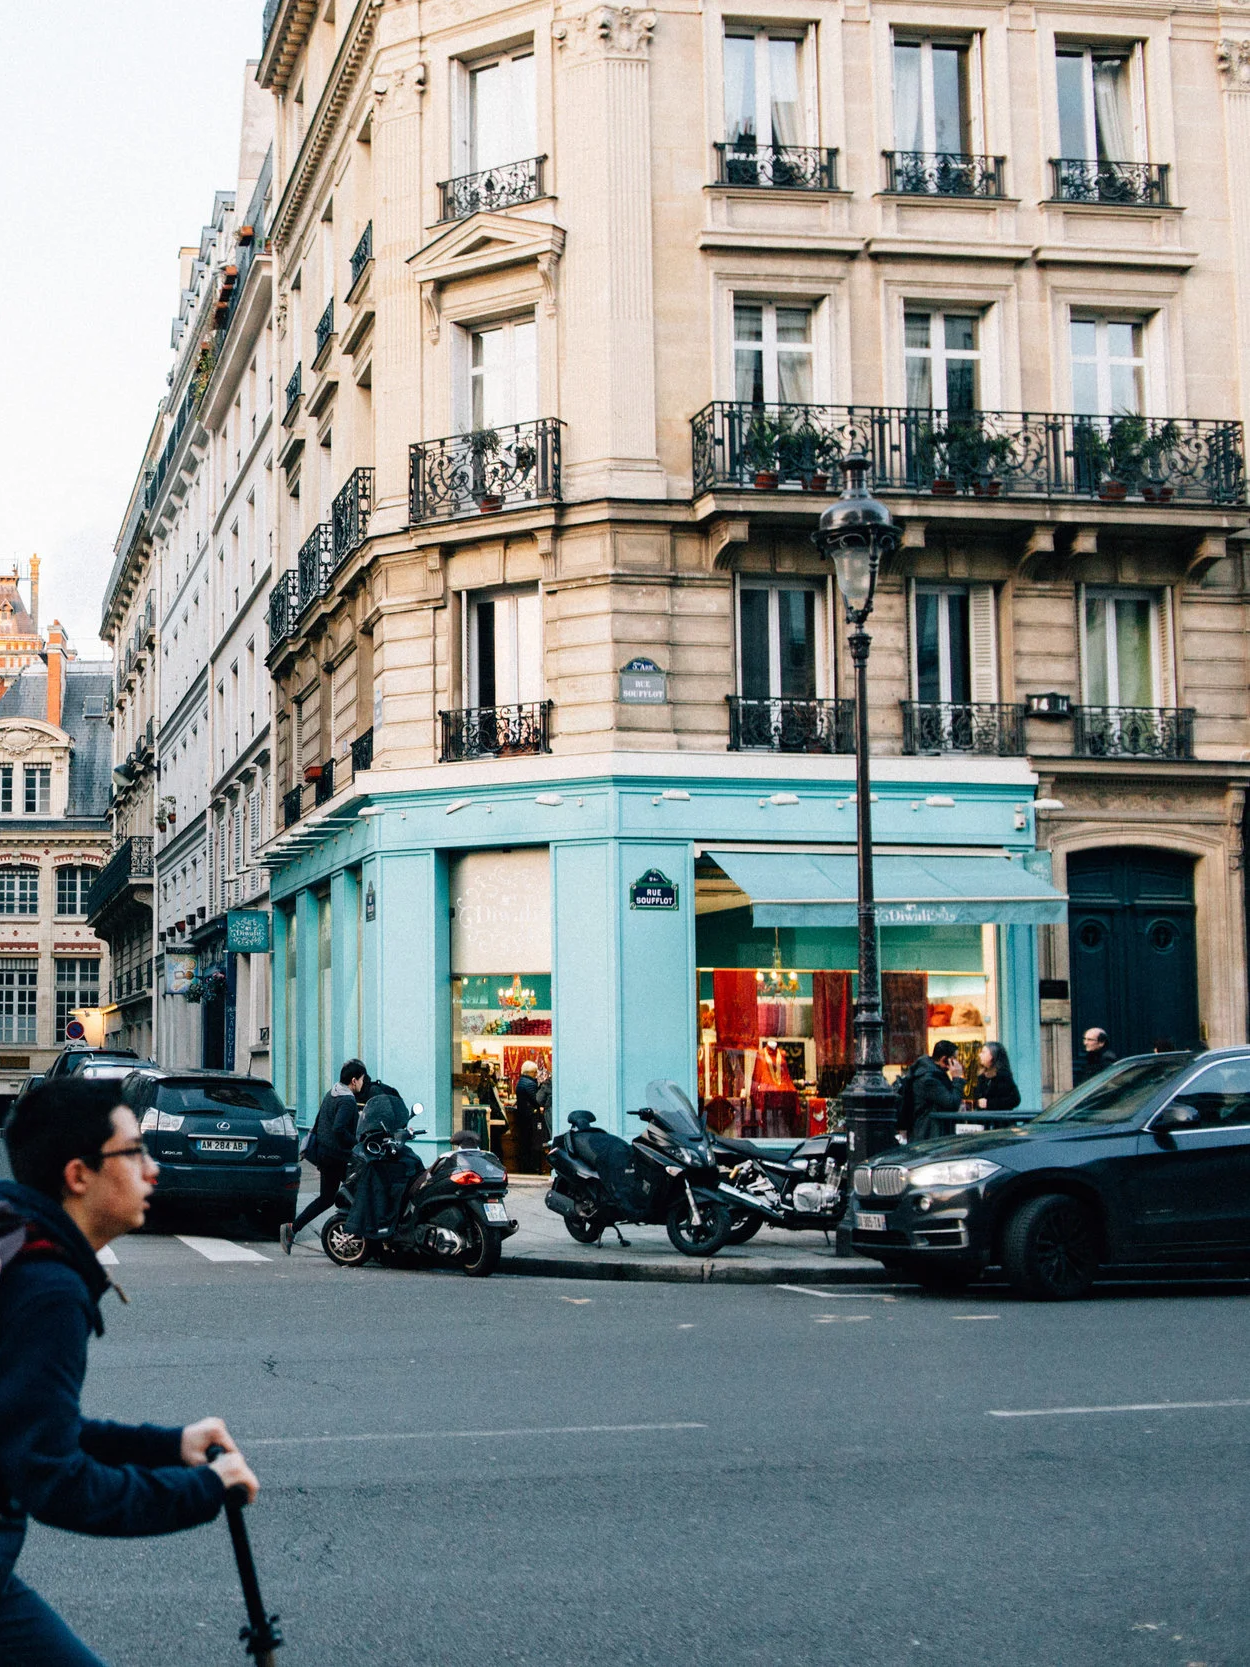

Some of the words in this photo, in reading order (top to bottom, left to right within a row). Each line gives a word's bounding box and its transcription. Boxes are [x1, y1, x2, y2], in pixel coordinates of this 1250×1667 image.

[622, 690, 664, 698] SOUFFLOT
[1030, 698, 1049, 711] 14
[646, 888, 662, 897] RUE
[636, 896, 673, 905] SOUFFLOT
[889, 909, 931, 922] Diwali
